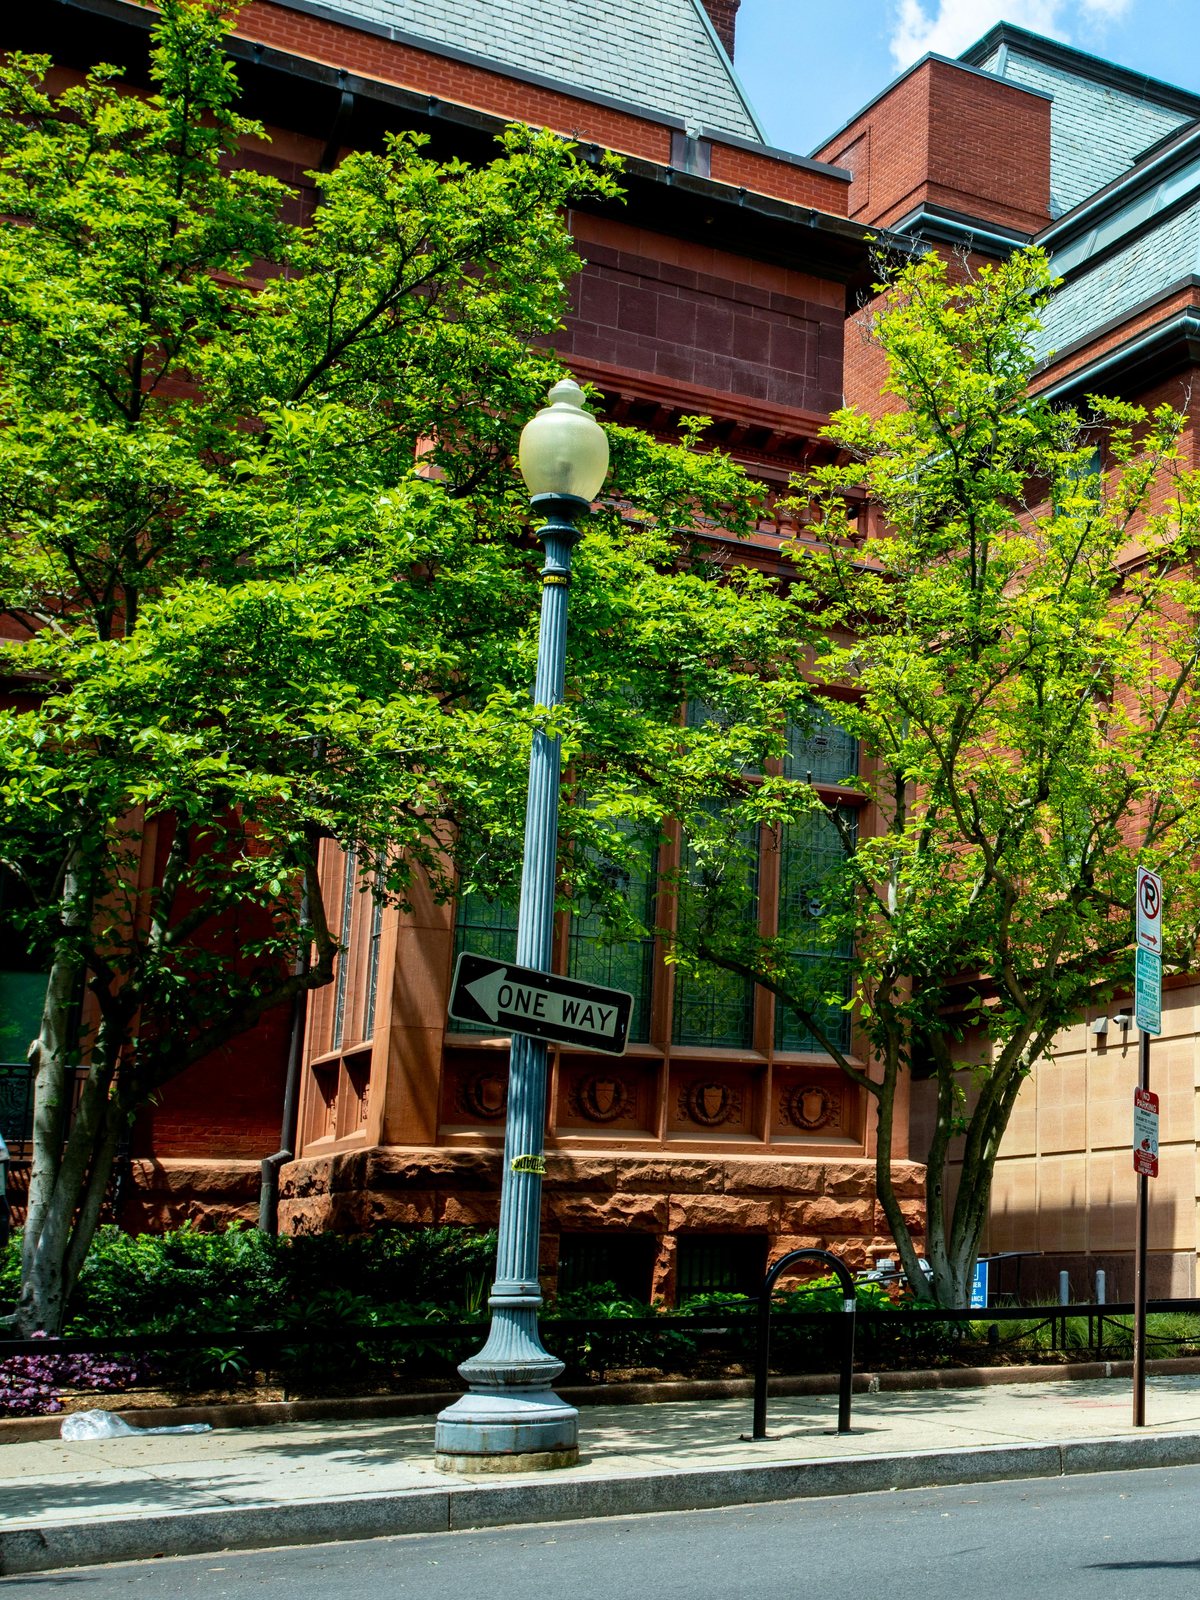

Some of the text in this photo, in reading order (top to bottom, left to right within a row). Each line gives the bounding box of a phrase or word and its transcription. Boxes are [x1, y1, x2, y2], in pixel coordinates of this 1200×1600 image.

[497, 985, 613, 1031] ONE WAY
[1137, 1099, 1157, 1112] PARKING
